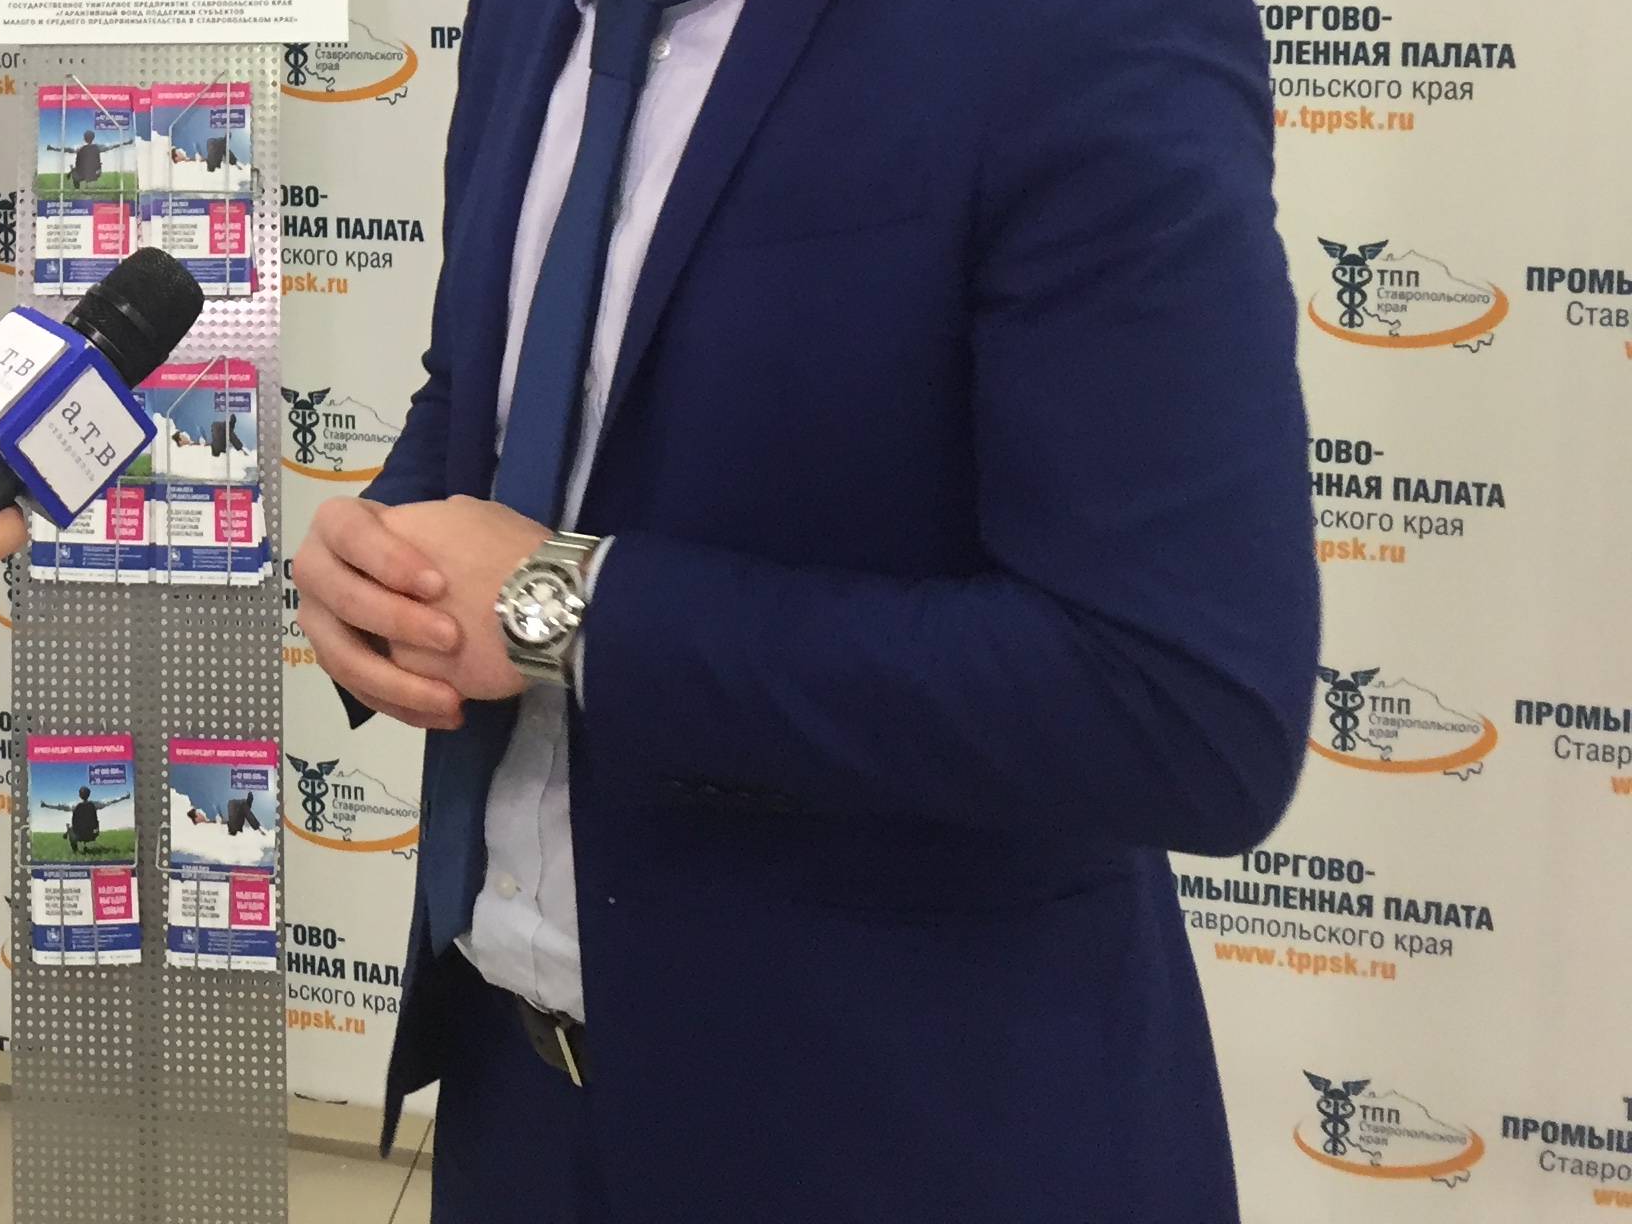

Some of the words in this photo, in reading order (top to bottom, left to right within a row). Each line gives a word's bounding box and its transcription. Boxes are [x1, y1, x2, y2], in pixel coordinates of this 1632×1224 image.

[1400, 42, 1517, 70] ПАЛАТА
[1412, 79, 1474, 105] края
[337, 217, 424, 242] ПАЛАТА
[345, 250, 393, 272] края
[1377, 269, 1420, 288] ТПП
[323, 413, 356, 429] ТПП
[1393, 477, 1506, 508] ПАЛАТА
[1403, 515, 1464, 539] края
[1316, 538, 1405, 564] psk.ru
[1369, 694, 1411, 716] ТПП
[332, 783, 364, 802] ТПП
[1174, 874, 1374, 919] МЫШЛЕННАЯ
[1384, 896, 1494, 932] ПАЛАТА
[1394, 930, 1454, 959] края
[1214, 940, 1397, 980] www.tppsk.ru
[1359, 1103, 1400, 1125] ТПП
